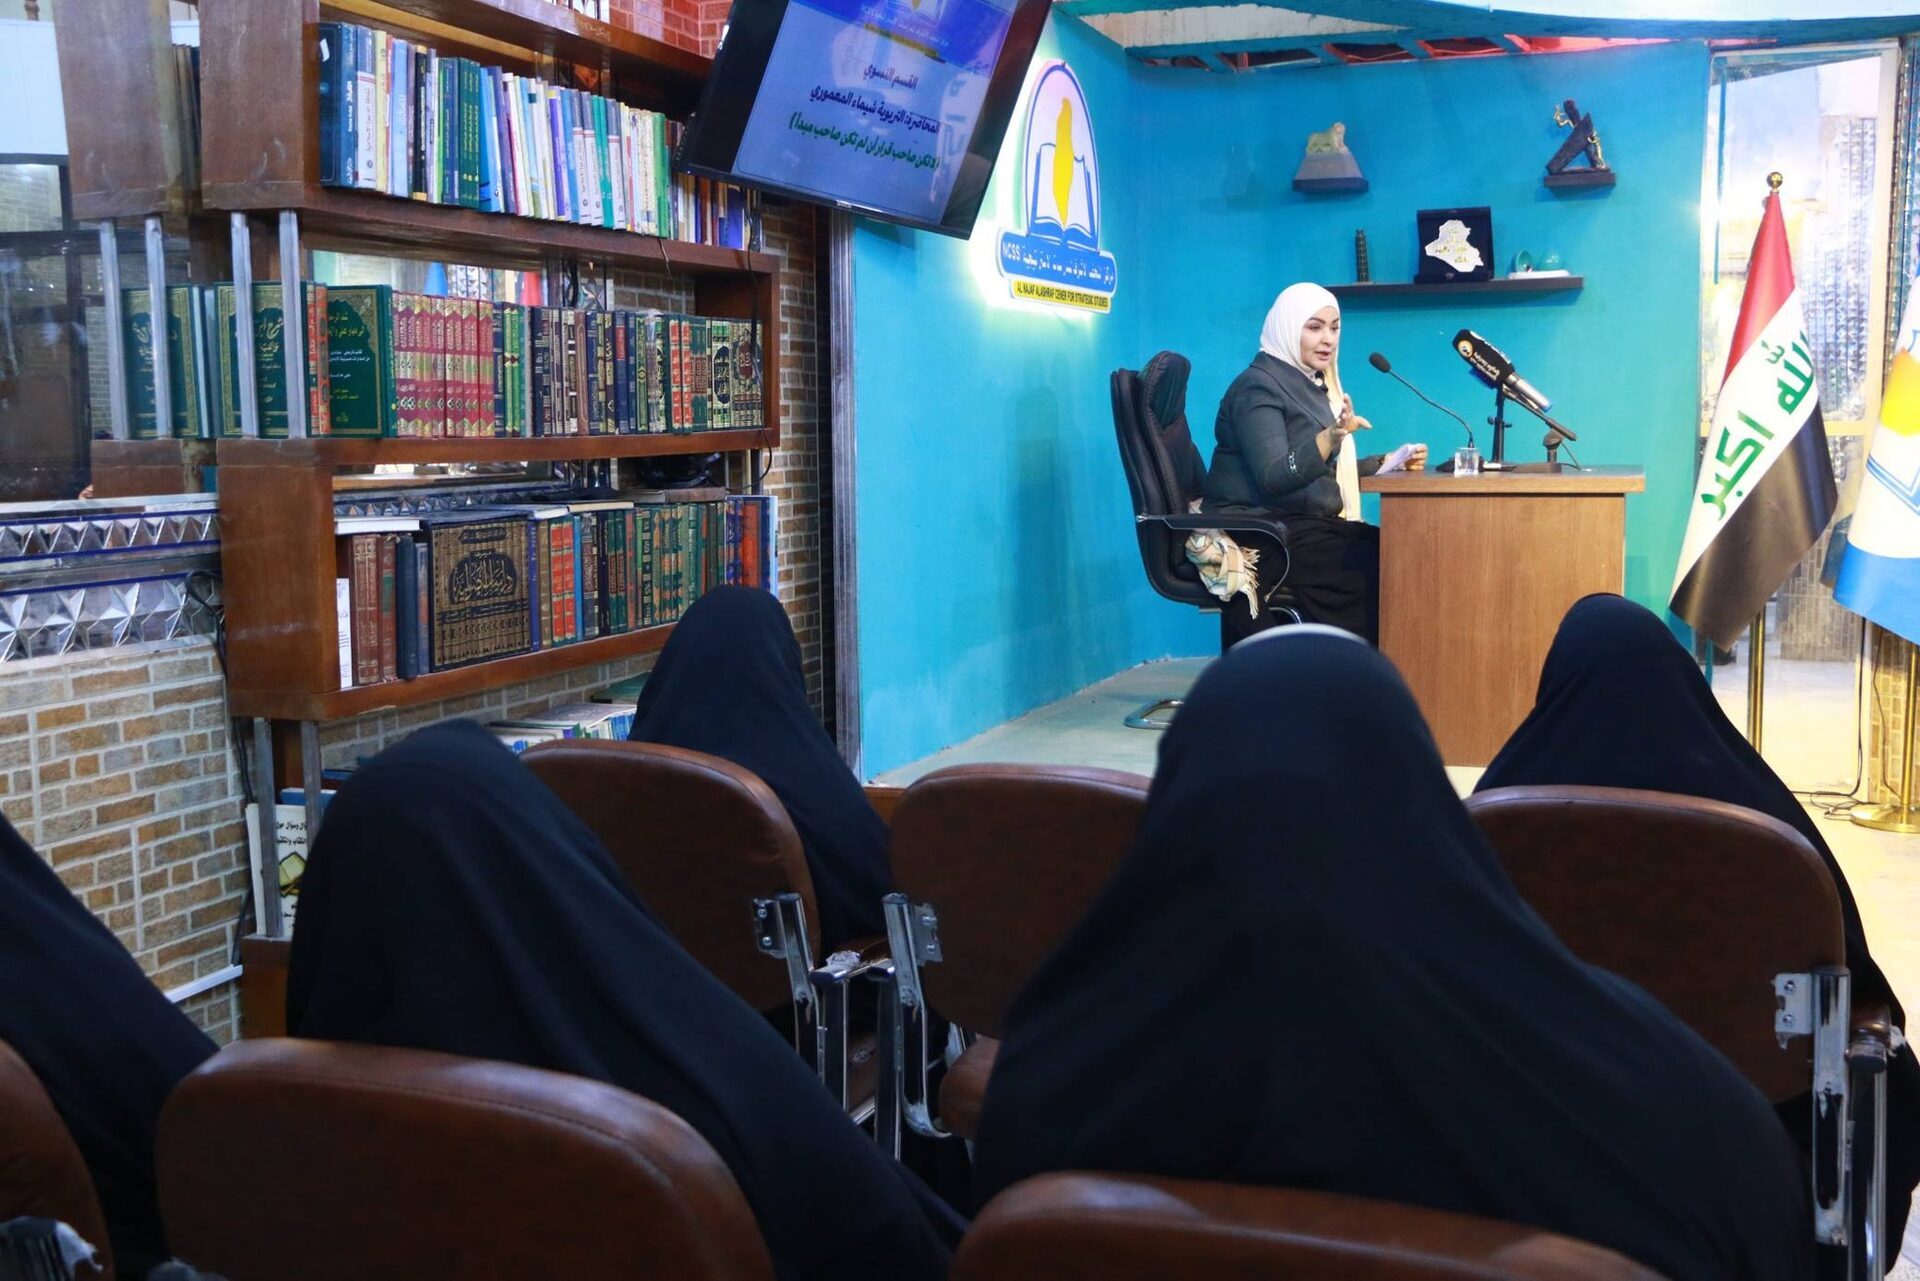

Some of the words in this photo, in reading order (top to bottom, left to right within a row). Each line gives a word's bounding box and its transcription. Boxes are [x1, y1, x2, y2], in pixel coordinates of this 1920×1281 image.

[863, 64, 895, 81] النسوي
[891, 74, 918, 90] القسم
[810, 86, 854, 106] المعموري
[852, 95, 877, 116] شيماء
[877, 101, 906, 124] التربوية
